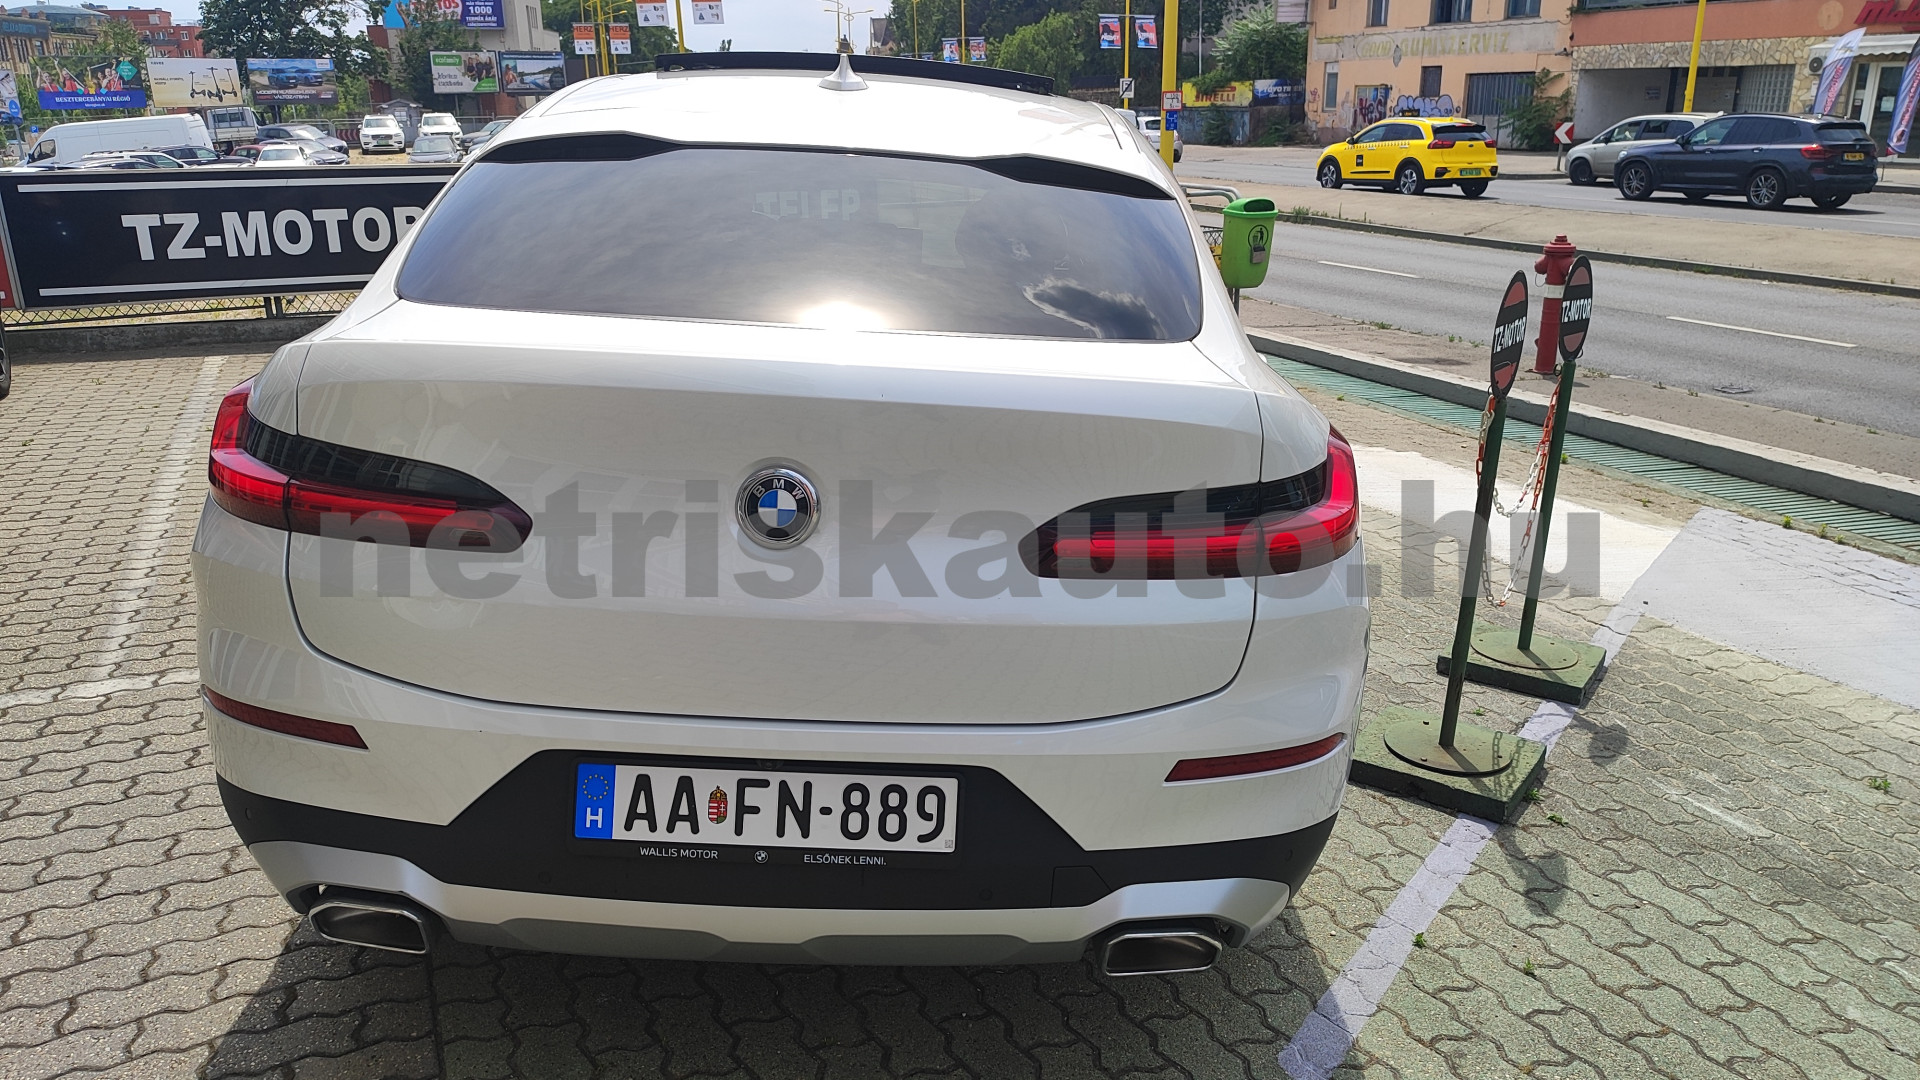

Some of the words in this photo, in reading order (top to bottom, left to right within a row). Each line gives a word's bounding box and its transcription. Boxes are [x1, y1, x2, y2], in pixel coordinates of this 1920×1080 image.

[1361, 40, 1392, 57] GOOD
[1400, 32, 1510, 56] GUMISZERVIZ
[1561, 297, 1591, 323] TZ-MOTOR
[1494, 316, 1526, 353] TZ-MOTOR
[753, 479, 805, 500] BMW
[585, 806, 603, 829] H
[624, 773, 700, 835] AA
[734, 778, 946, 844] FN-889
[639, 846, 677, 858] WALLIS
[680, 848, 718, 860] MOTOR
[804, 852, 851, 866] ELSŐNEK
[853, 855, 887, 867] LENNI.
